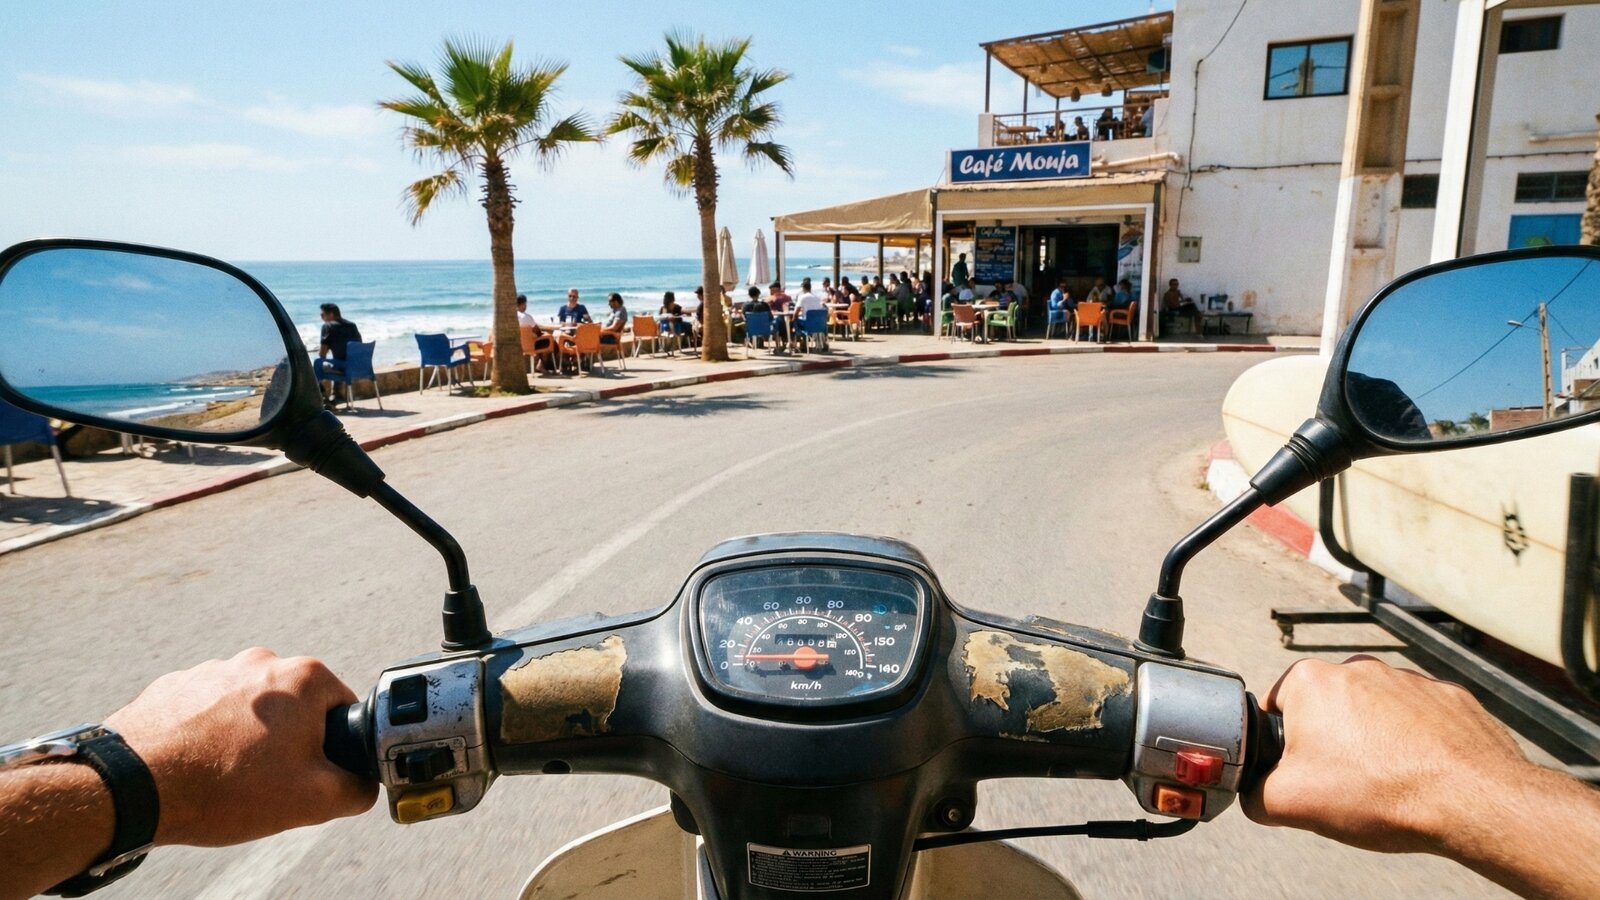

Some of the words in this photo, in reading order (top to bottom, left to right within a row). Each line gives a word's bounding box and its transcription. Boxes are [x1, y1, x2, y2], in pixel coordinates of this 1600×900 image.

[960, 152, 1005, 178] Café
[795, 596, 812, 605] 80
[827, 600, 844, 609] 80
[763, 602, 780, 610] 60
[737, 616, 753, 625] 40
[719, 639, 736, 648] 20
[874, 637, 895, 646] 150
[720, 661, 729, 670] 0
[790, 681, 822, 690] km/h
